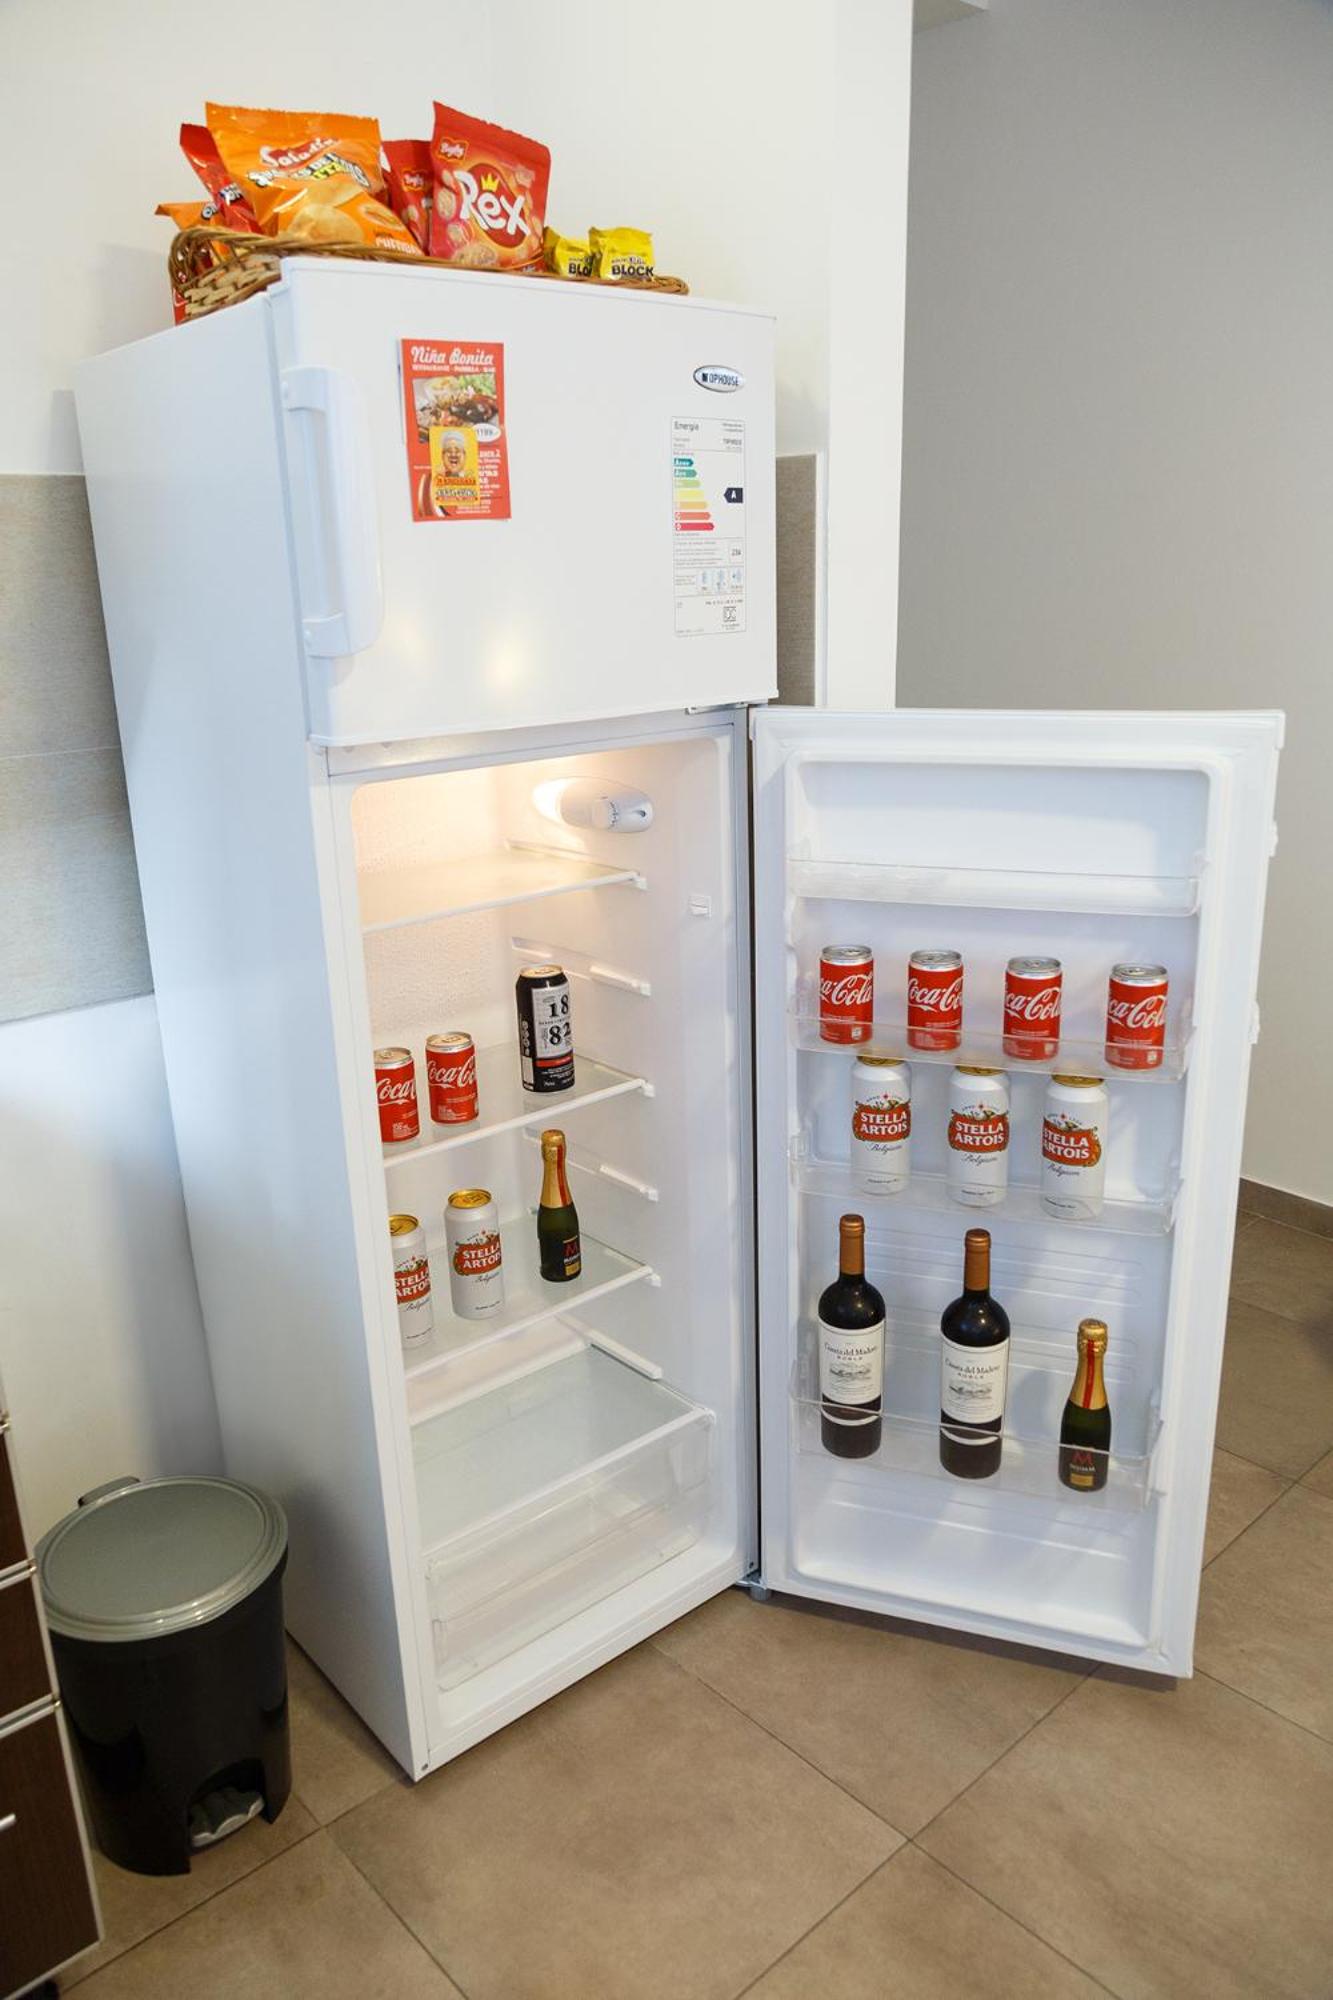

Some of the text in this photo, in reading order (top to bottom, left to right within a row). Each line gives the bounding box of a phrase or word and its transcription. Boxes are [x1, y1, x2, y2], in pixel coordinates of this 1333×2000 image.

[453, 170, 531, 236] Rex
[611, 265, 654, 277] BLOCK
[411, 346, 494, 365] Niña Bonita
[730, 489, 737, 500] A
[861, 1111, 907, 1125] STELLA
[861, 1120, 907, 1136] ARTOIS
[955, 1121, 1004, 1135] STELLA
[955, 1133, 1004, 1146] ARTOIS
